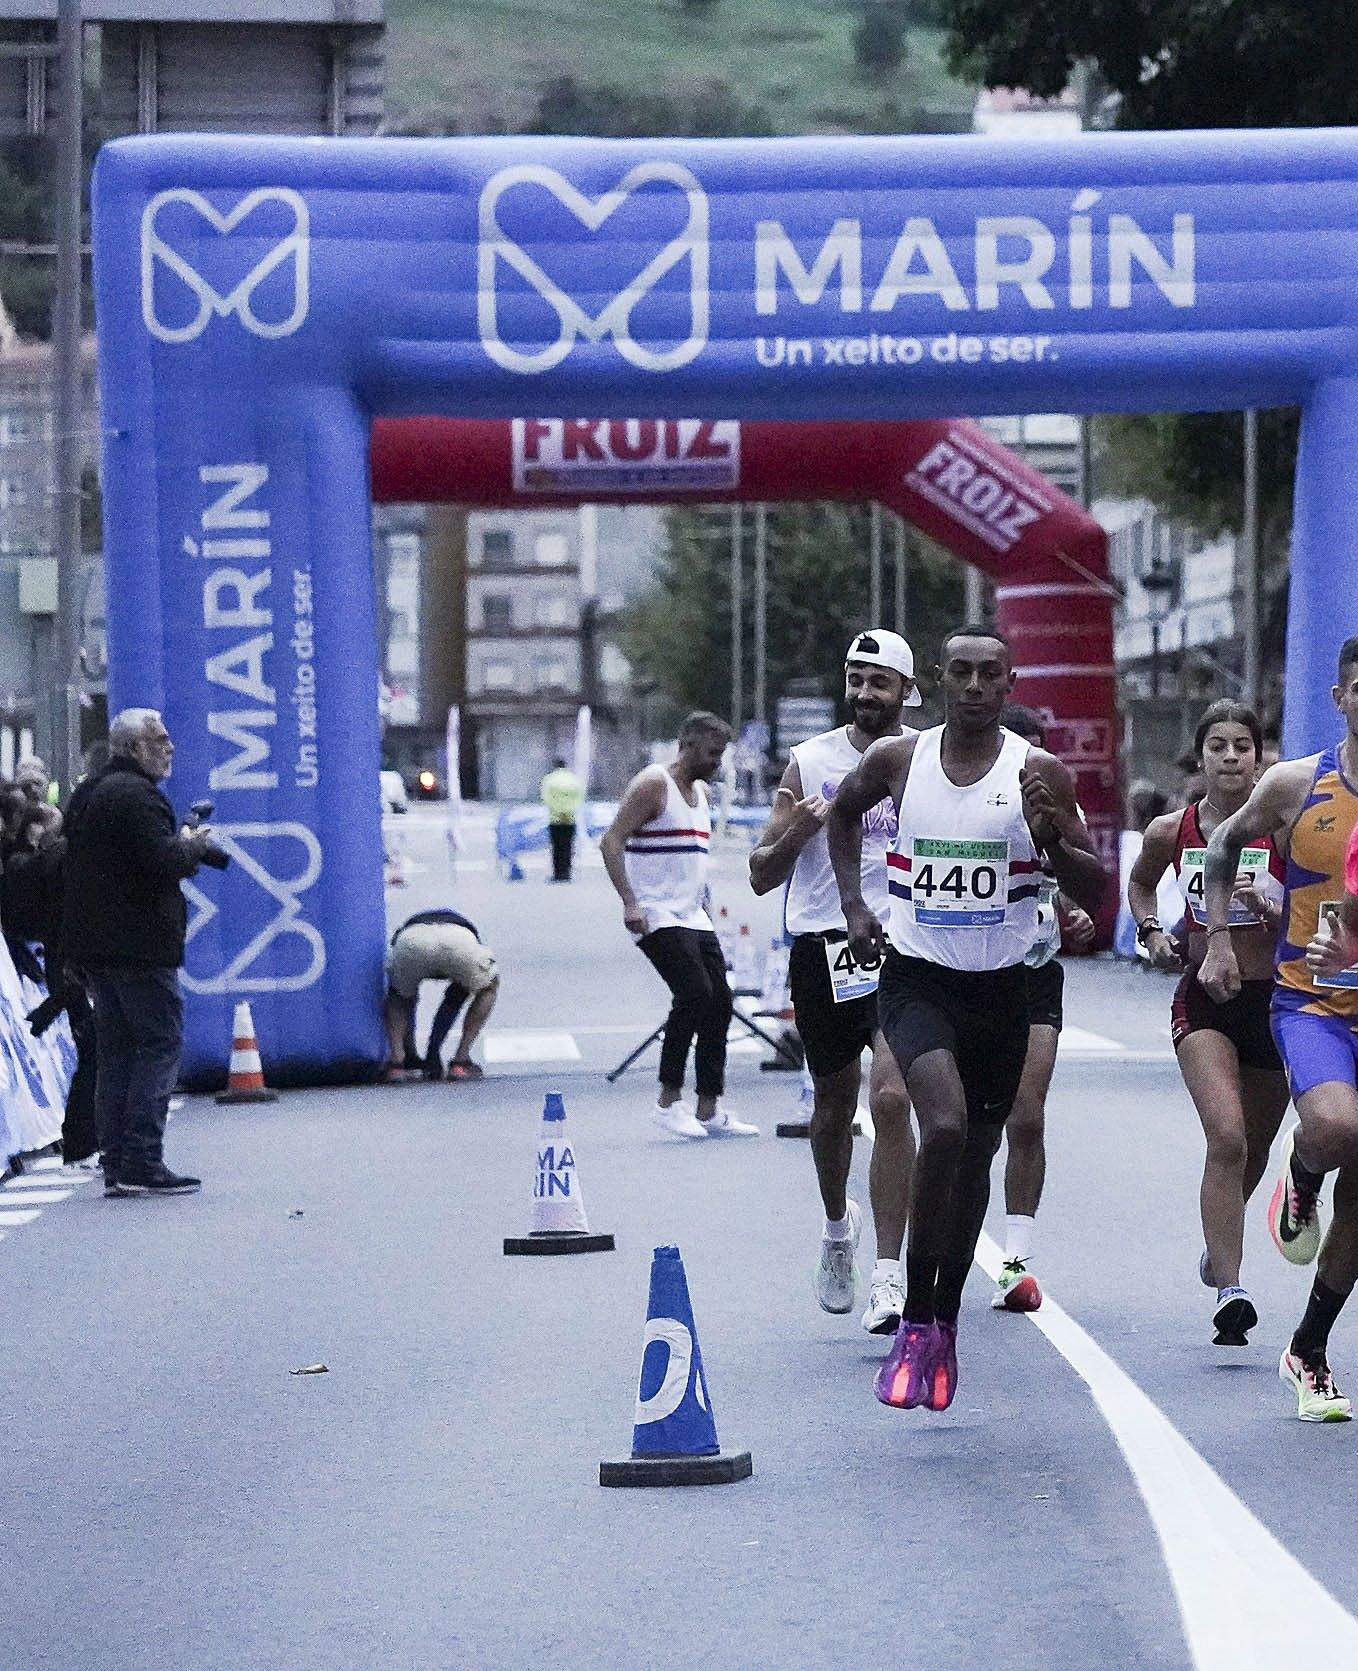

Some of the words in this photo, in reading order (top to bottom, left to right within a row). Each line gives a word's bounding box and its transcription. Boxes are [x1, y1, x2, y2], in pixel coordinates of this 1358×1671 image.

[755, 187, 1197, 315] MARÍN
[755, 336, 813, 367] Un
[823, 335, 923, 365] xeito
[930, 332, 985, 363] de
[990, 336, 1059, 363] ser.
[916, 440, 1041, 541] FROIZ
[182, 462, 279, 790] MARÍN
[290, 619, 315, 660] de
[295, 743, 319, 788] Un
[913, 864, 997, 900] 440
